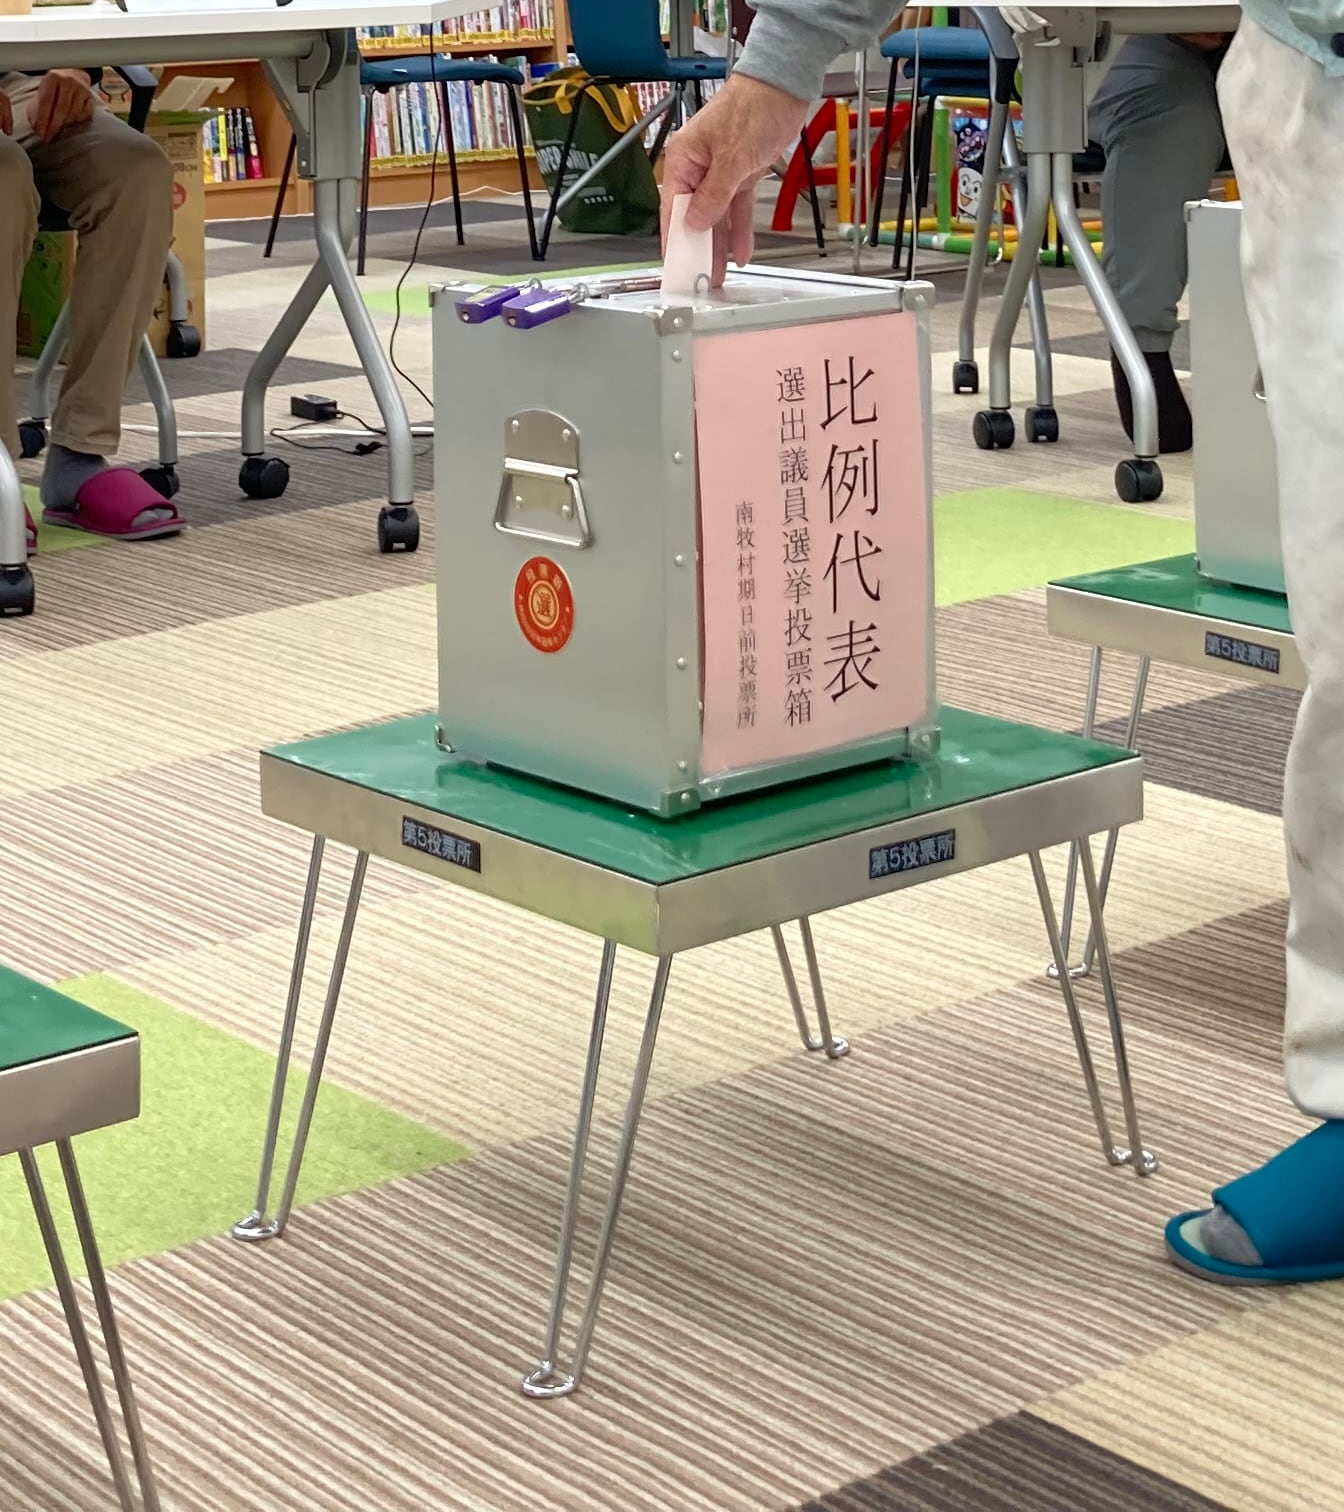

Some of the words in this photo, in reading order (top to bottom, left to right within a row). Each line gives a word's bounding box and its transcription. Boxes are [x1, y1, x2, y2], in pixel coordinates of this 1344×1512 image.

[774, 366, 814, 728] 選出議員選挙投票箱
[819, 354, 884, 704] 比例代表
[735, 499, 757, 729] 南牧村期日前投票所
[1207, 634, 1278, 670] 第5投票所
[403, 819, 473, 867] 第5投票所
[871, 833, 954, 878] 第5投票所
